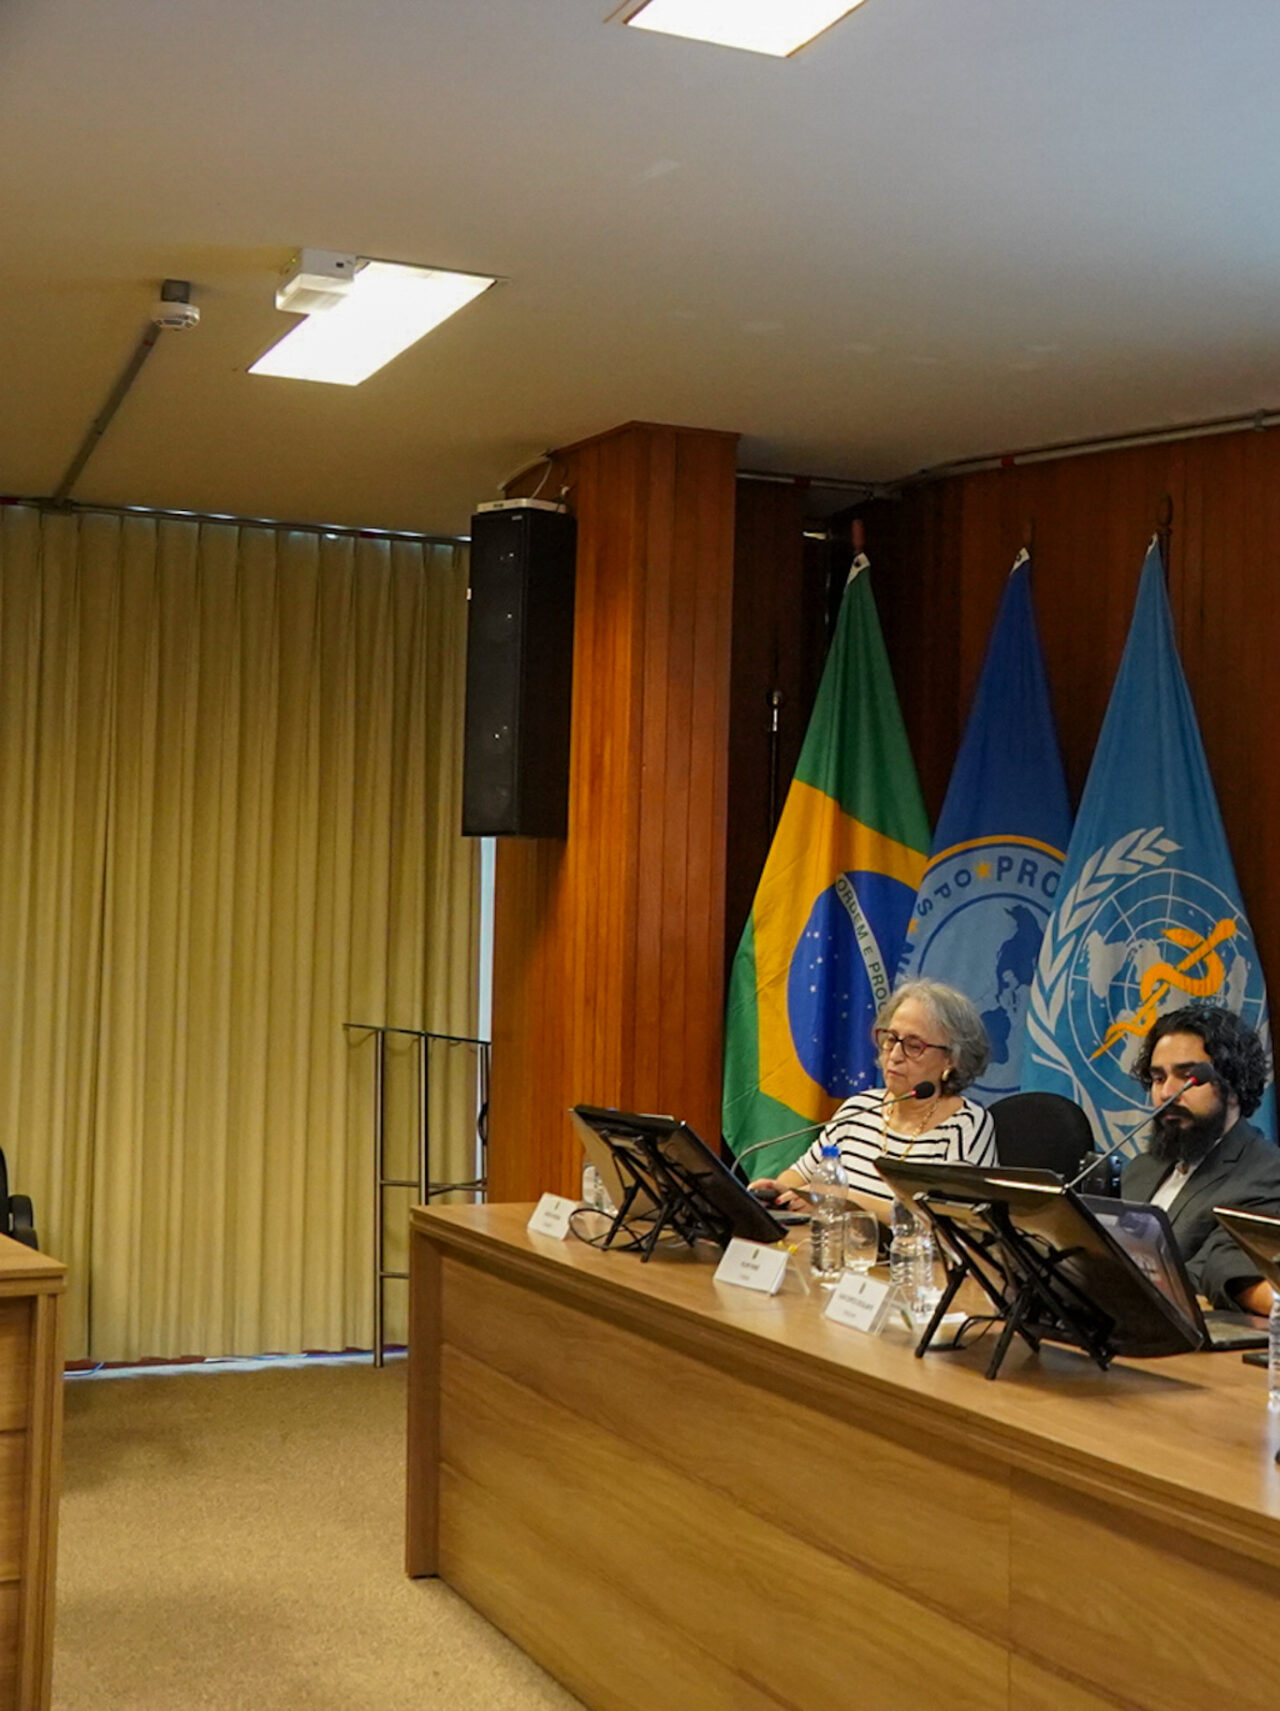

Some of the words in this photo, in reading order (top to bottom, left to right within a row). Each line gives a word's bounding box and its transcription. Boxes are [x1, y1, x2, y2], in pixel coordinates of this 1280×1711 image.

[997, 855, 1061, 899] PRO
[837, 879, 869, 940] ORDEM
[863, 946, 874, 956] E
